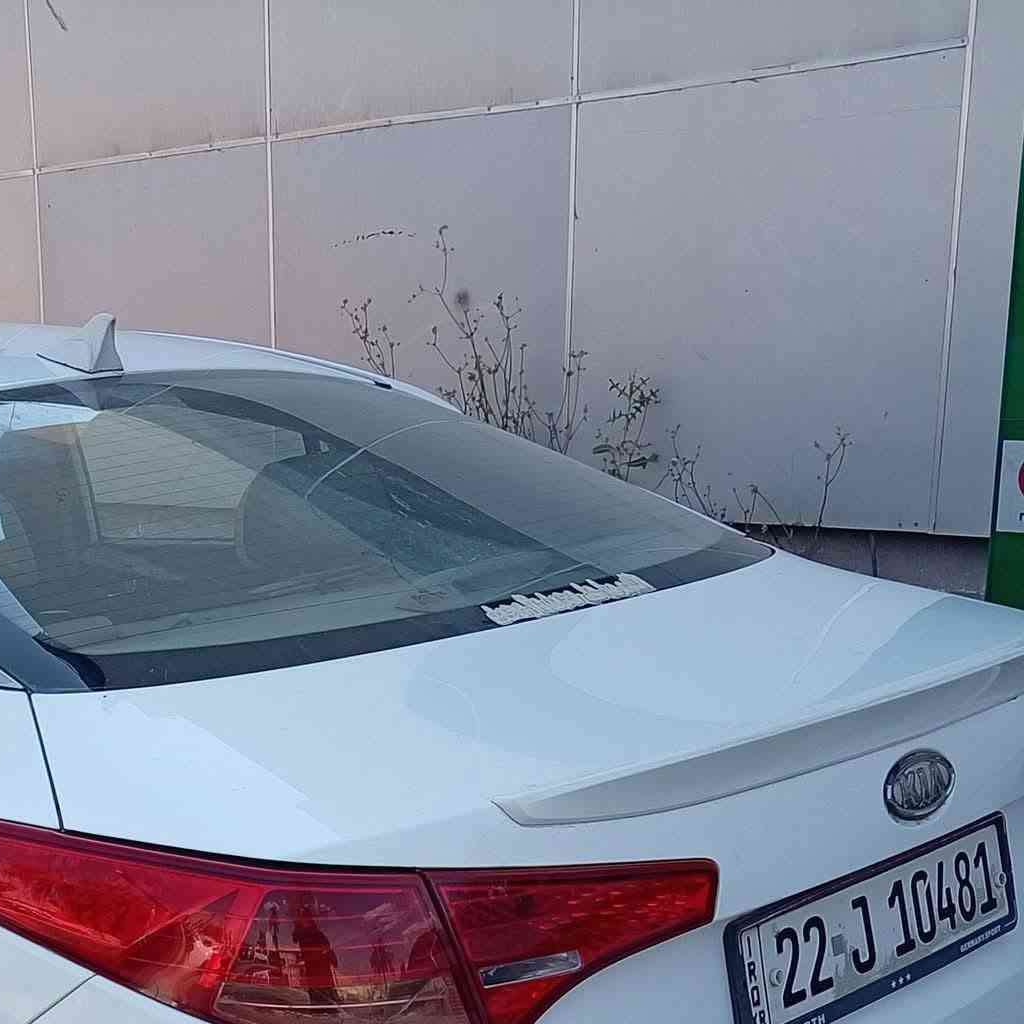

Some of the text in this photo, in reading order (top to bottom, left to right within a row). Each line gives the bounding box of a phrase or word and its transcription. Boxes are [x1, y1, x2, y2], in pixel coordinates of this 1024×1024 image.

[776, 842, 997, 1009] 22 J 10481
